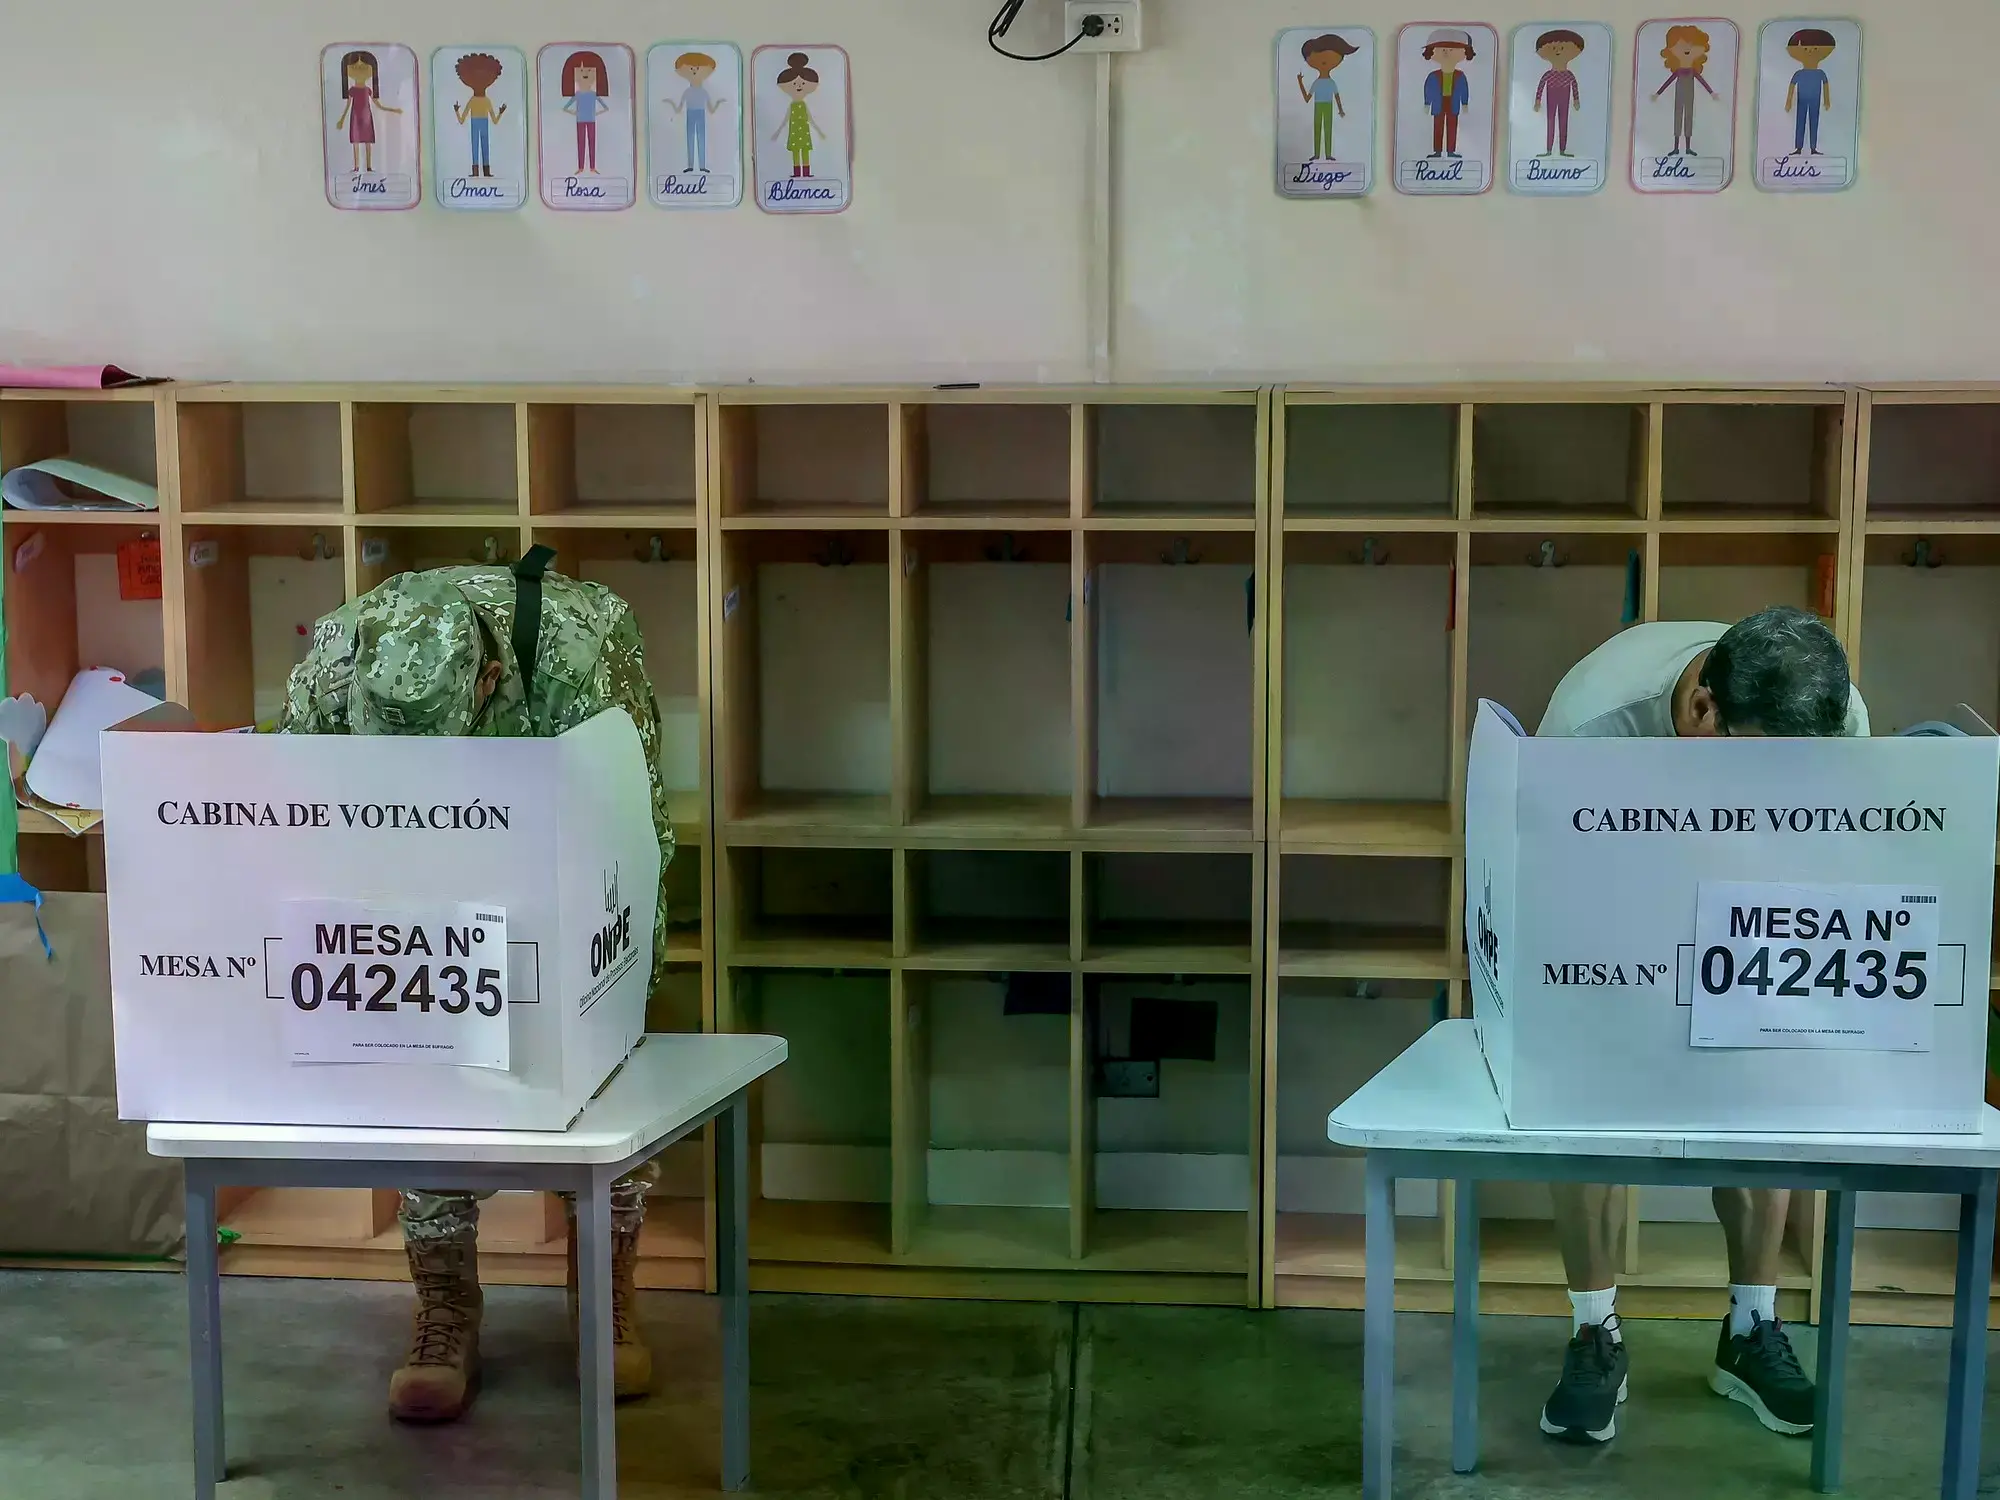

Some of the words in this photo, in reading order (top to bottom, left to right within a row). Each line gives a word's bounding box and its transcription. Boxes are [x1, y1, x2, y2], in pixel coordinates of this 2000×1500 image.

[1293, 162, 1352, 190] Diego
[1415, 160, 1463, 180] Raúl
[1526, 159, 1591, 180] Bruno
[1652, 156, 1696, 178] Lola
[1773, 156, 1821, 177] Luis
[450, 178, 504, 198] Omar
[565, 176, 606, 197] Rosa
[660, 174, 708, 194] Paul
[768, 179, 836, 201] Blanca
[157, 800, 281, 827] CABINA
[285, 803, 331, 827] DE
[337, 797, 511, 831] VOTACIÓN
[1572, 807, 1703, 833] CABINA
[1709, 808, 1757, 832] DE
[1764, 799, 1947, 833] VOTACIÓN
[1729, 906, 1853, 941] MESA
[1864, 907, 1912, 942] Nº
[315, 923, 434, 957] MESA
[445, 924, 486, 958] Nº
[591, 906, 630, 977] ONPE
[1478, 906, 1498, 980] ONPE
[139, 954, 221, 978] MESA
[1541, 963, 1630, 986] MESA
[1700, 945, 1928, 1000] 042435
[290, 962, 503, 1017] 042435
